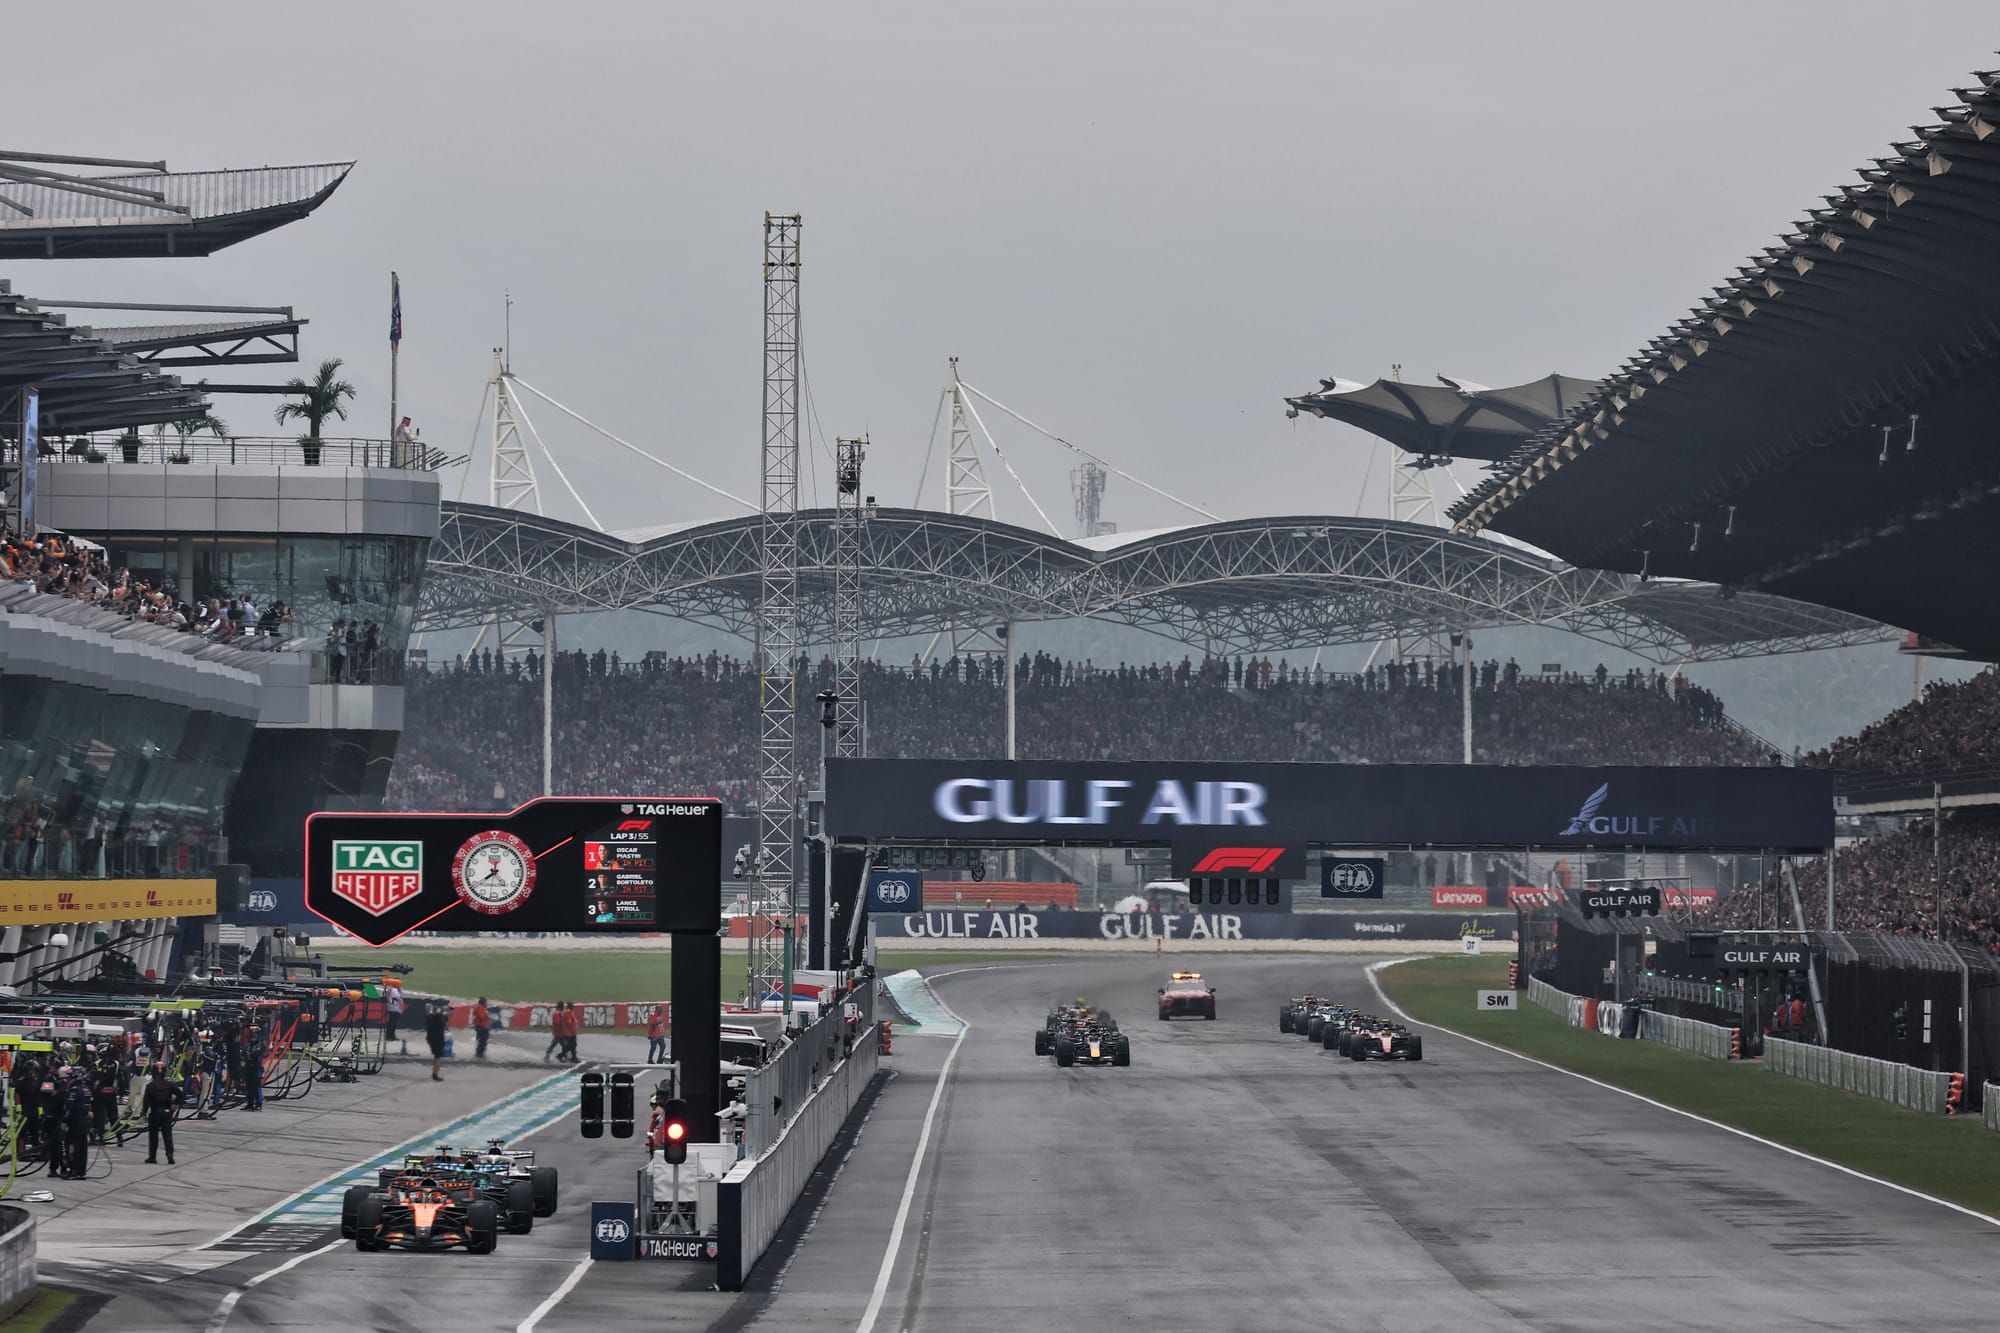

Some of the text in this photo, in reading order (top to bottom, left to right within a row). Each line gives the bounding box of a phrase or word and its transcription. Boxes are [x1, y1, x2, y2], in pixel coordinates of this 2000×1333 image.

[933, 778, 1268, 826] GULF AIR
[1589, 816, 1664, 835] GULF
[341, 846, 414, 868] TAG
[588, 852, 596, 862] 1
[588, 879, 596, 889] 2
[338, 875, 416, 909] HEUER
[1436, 890, 1482, 904] Lenovo
[1588, 895, 1652, 906] GULF AIR
[588, 905, 596, 915] 3
[904, 913, 1039, 939] GULF AIR
[1100, 913, 1243, 940] GULF AIR
[1724, 951, 1801, 963] GULF AIR
[1487, 995, 1509, 1007] SM
